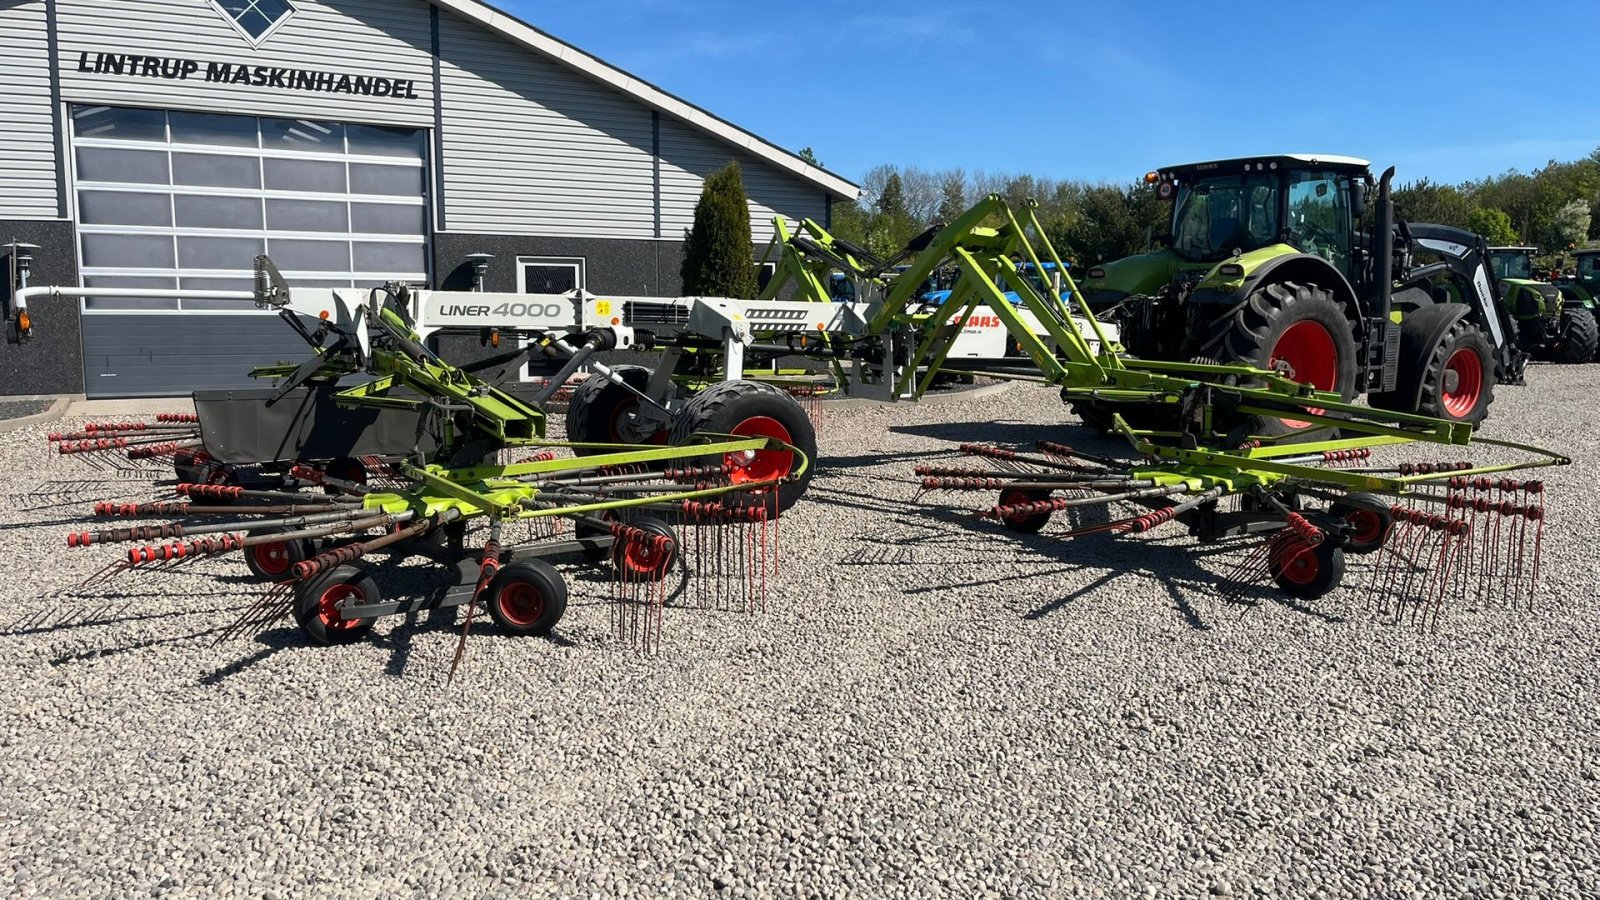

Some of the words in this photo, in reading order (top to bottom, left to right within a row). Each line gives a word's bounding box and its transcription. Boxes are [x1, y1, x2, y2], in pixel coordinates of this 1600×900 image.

[78, 51, 198, 80] LINTRUP
[205, 61, 419, 100] MASKINHANDEL
[439, 304, 490, 316] LINER
[491, 302, 561, 318] 4000
[954, 316, 1000, 327] CAAS
